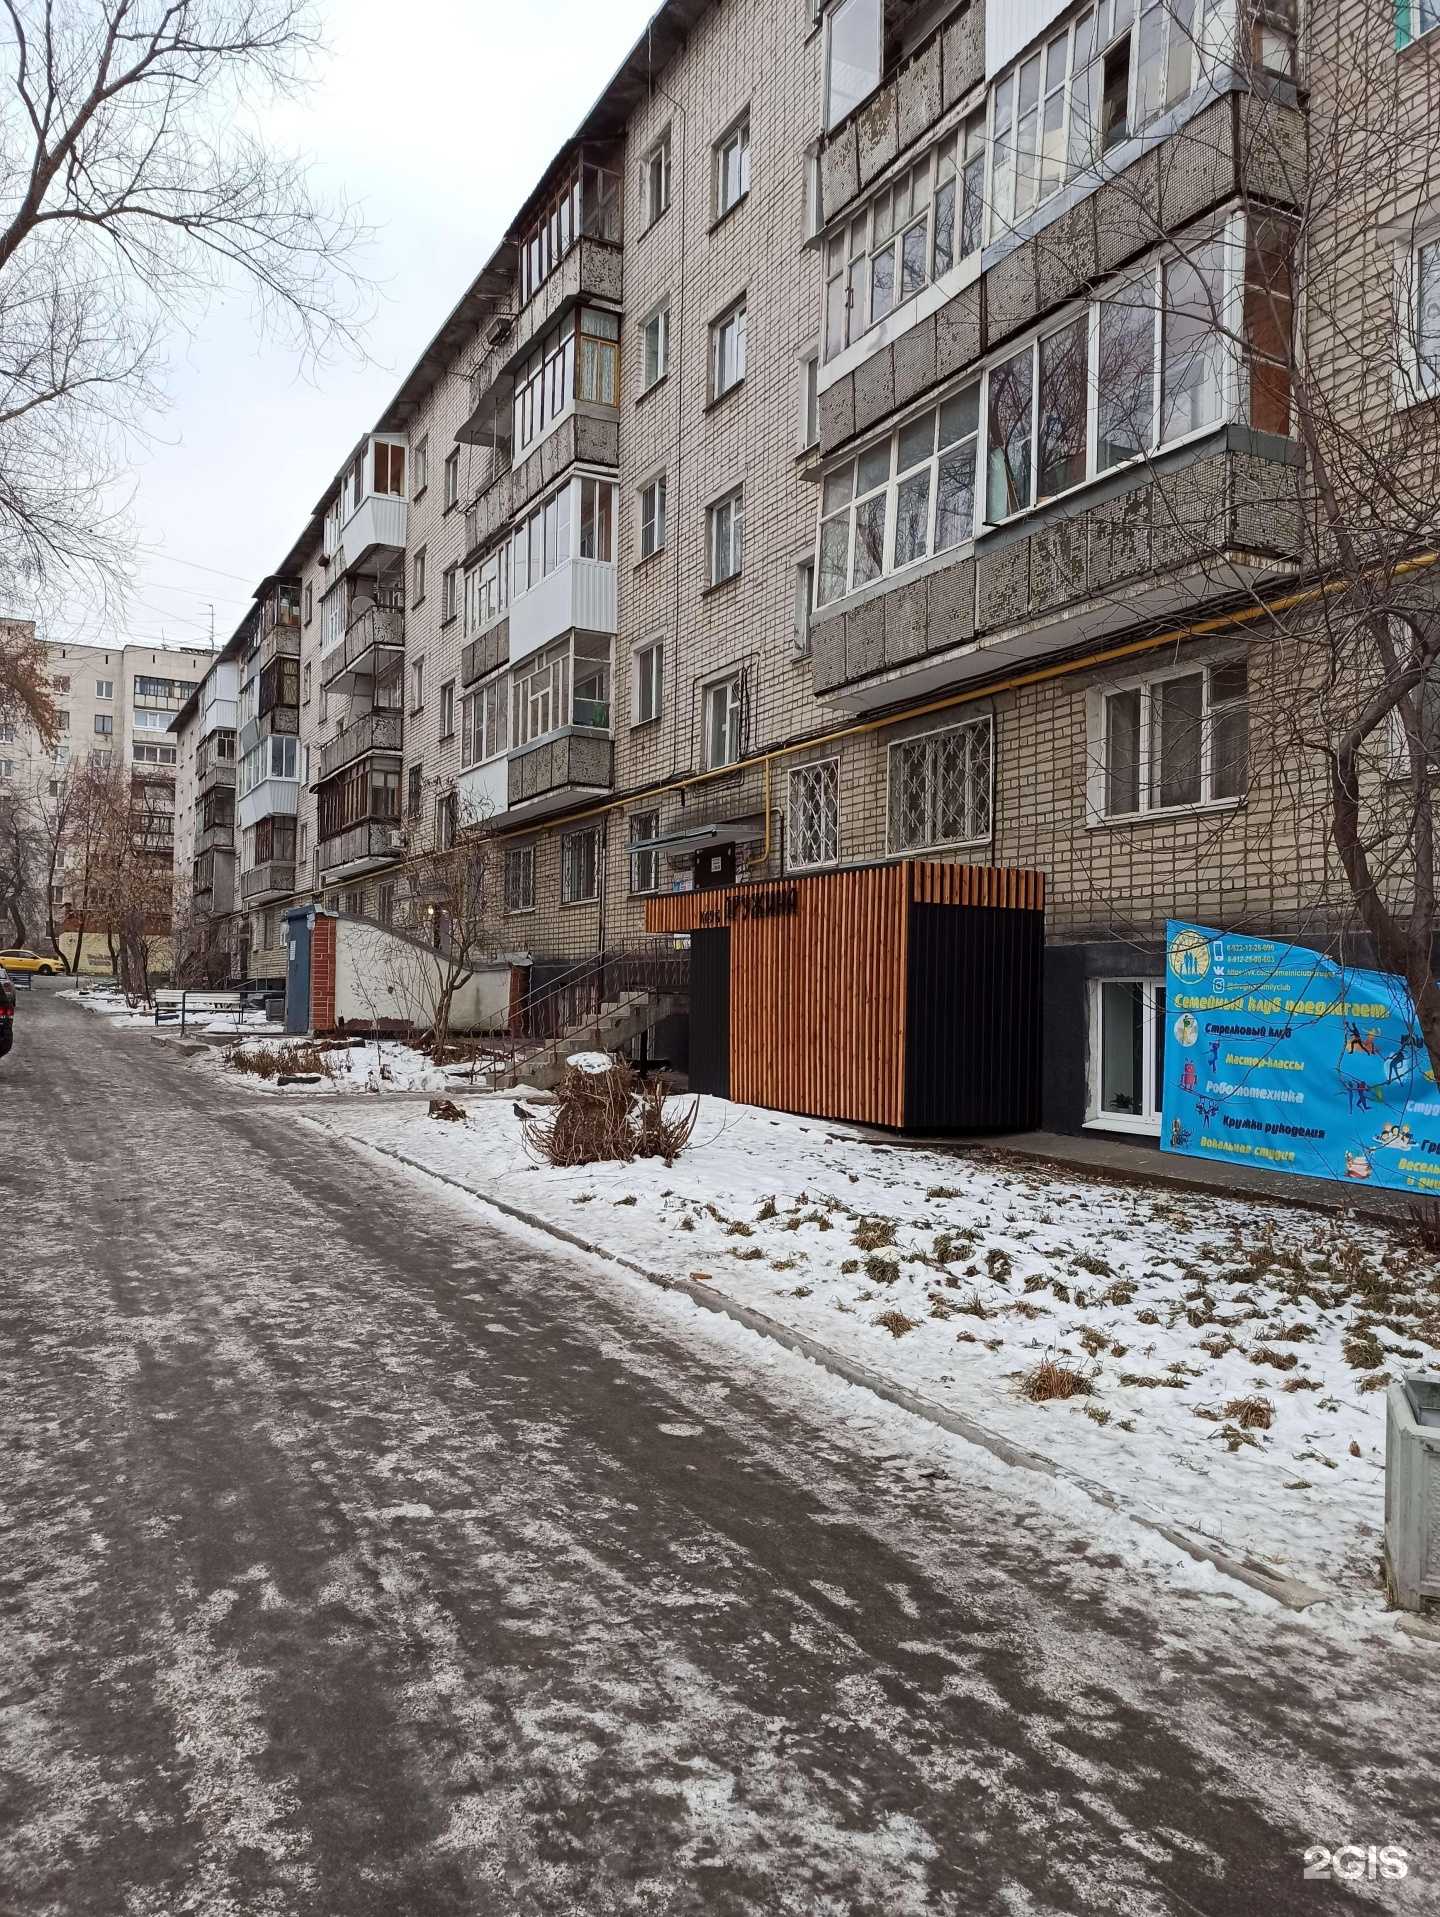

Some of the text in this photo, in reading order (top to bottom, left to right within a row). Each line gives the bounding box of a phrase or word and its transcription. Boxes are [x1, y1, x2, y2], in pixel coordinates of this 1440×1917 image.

[1174, 993, 1244, 1012] Семейный
[1247, 996, 1281, 1015] клуб
[1205, 1022, 1266, 1037] Стрелковый
[1205, 1080, 1305, 1104] Робототехника
[1222, 1114, 1326, 1138] Кружки рукоделия
